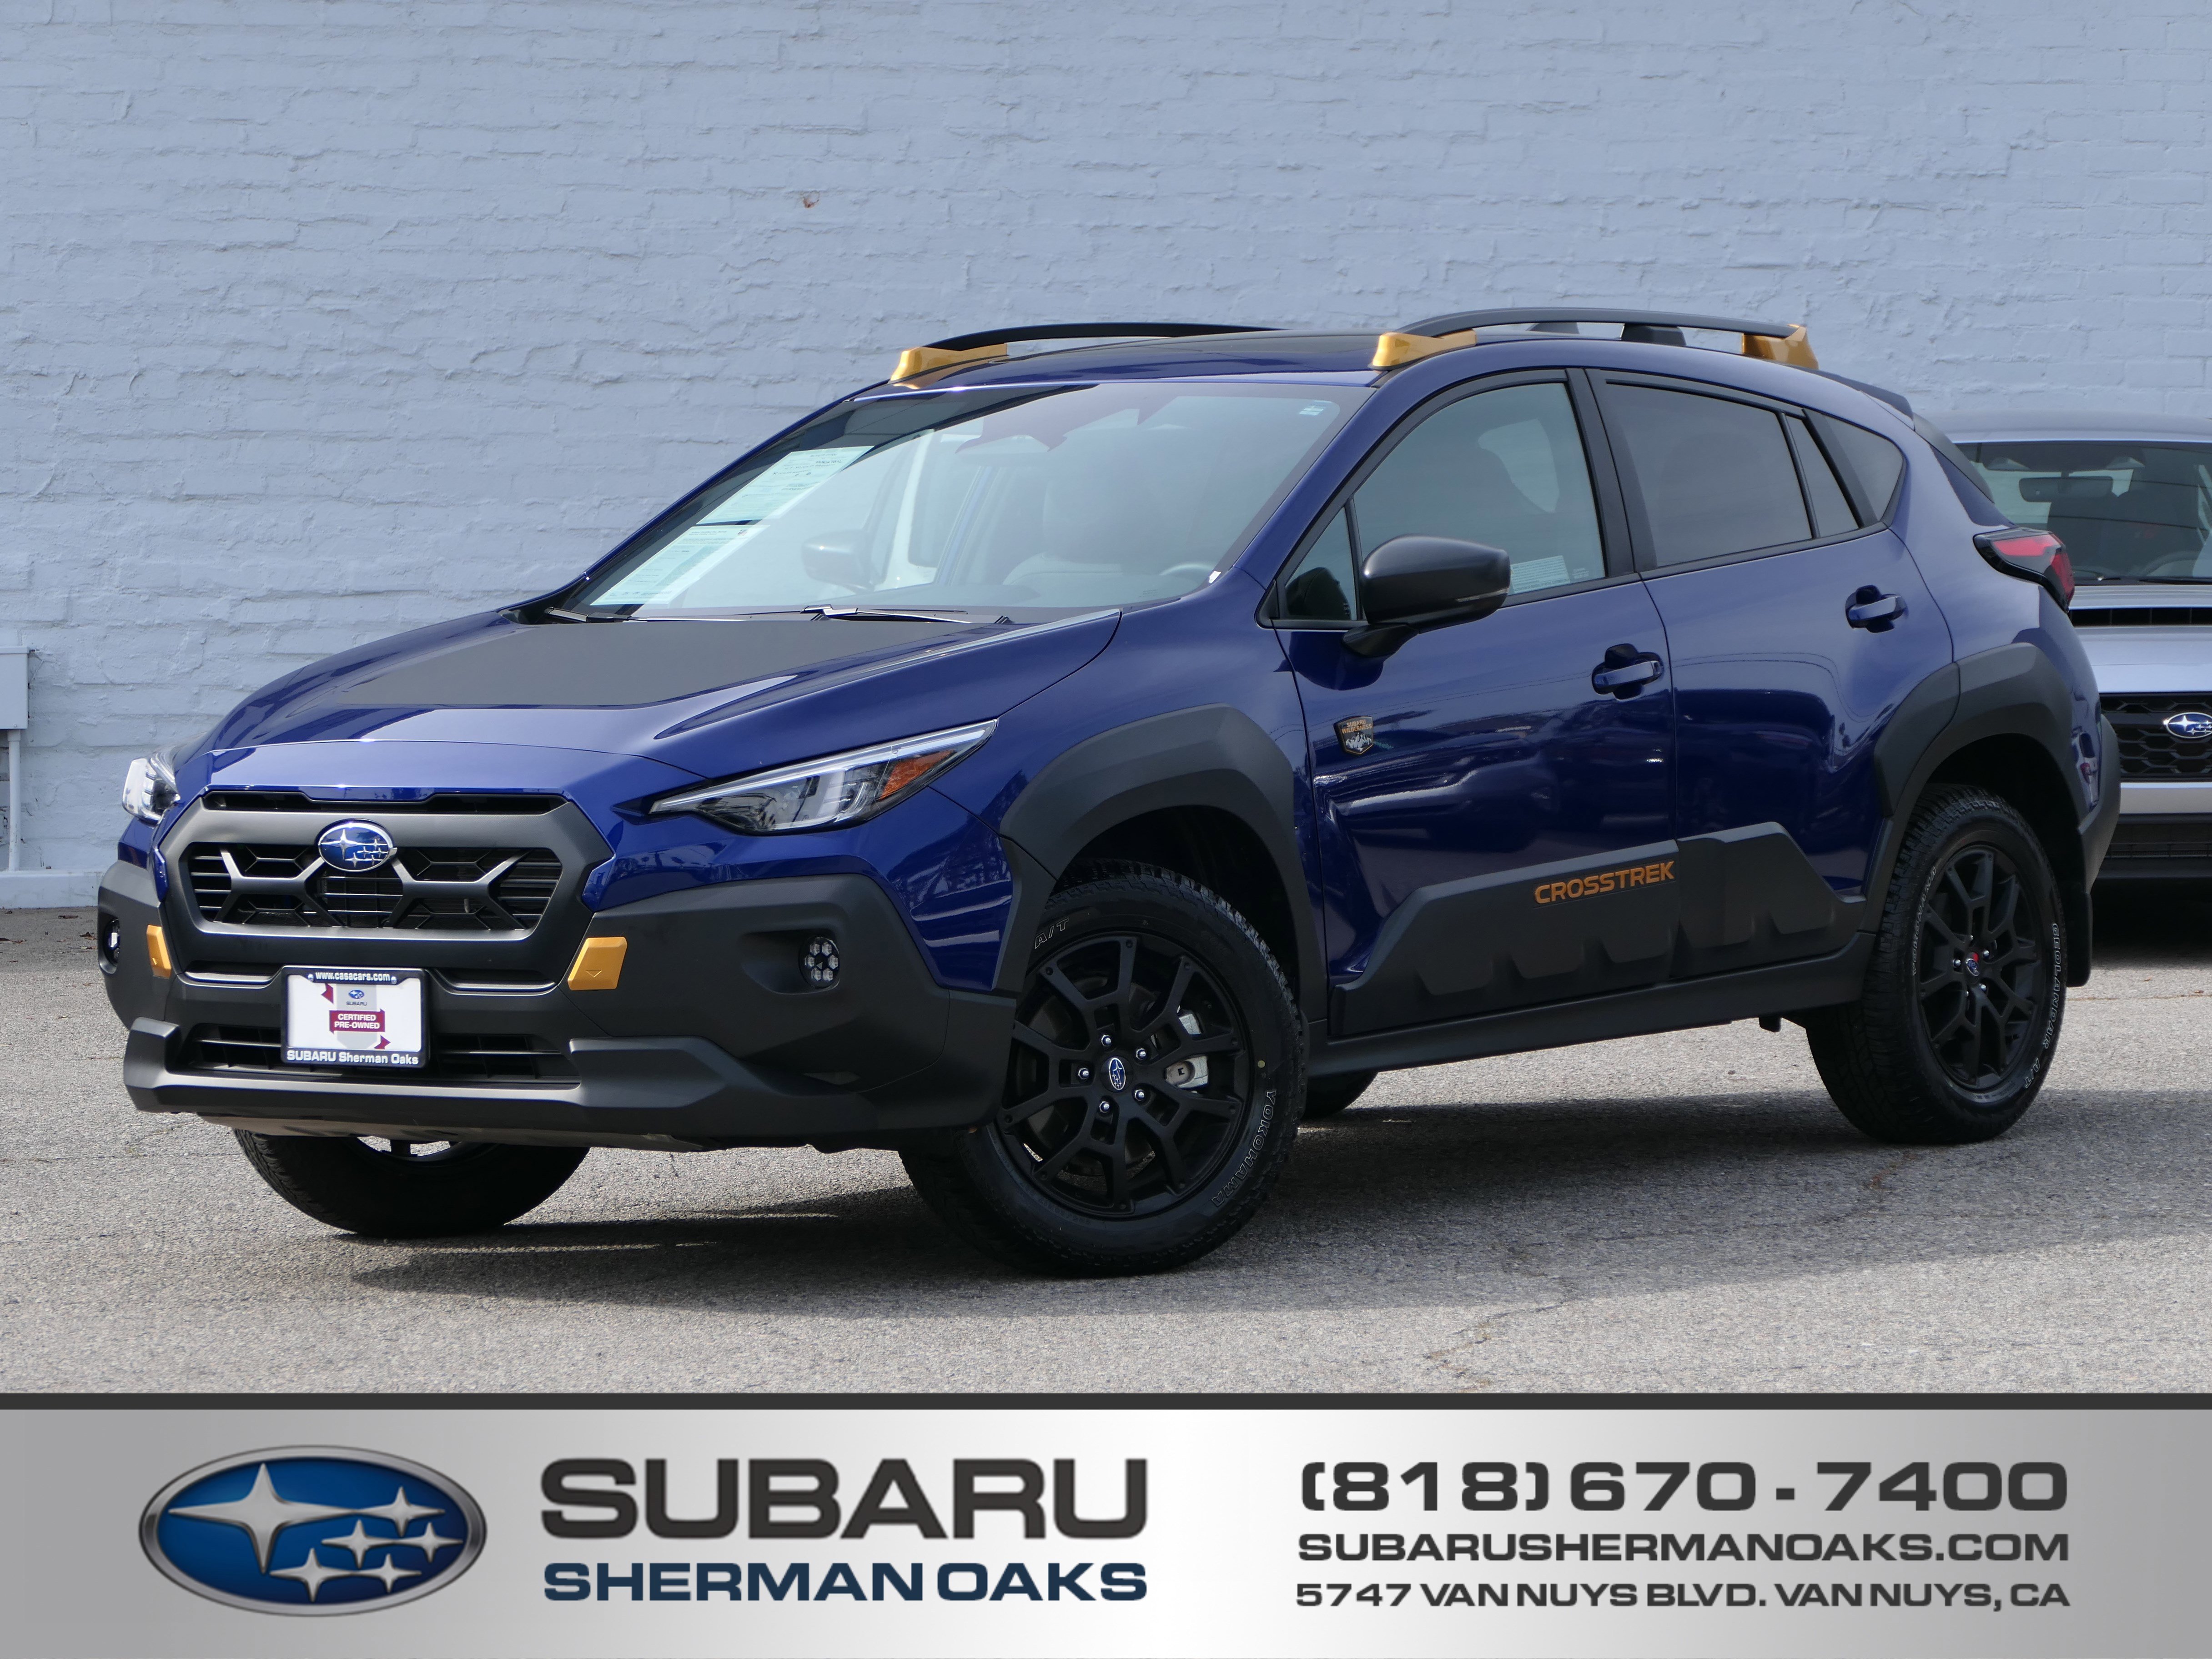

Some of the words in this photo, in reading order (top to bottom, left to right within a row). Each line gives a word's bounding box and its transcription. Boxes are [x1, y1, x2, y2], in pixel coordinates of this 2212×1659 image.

[1342, 724, 1372, 734] WILDERNESS
[1347, 719, 1366, 728] SUBARU
[1534, 861, 1674, 904] CROSSTREK
[1035, 918, 1069, 950] A/T
[315, 972, 391, 981] www.casacars.com
[2042, 923, 2061, 1049] GEOLANDAR
[337, 1013, 377, 1021] CERTIFIED
[287, 1050, 336, 1062] SUBARU
[339, 1052, 388, 1064] Sherman
[391, 1053, 419, 1065] Oaks
[2025, 1057, 2041, 1089] A/T
[1211, 1090, 1277, 1207] YOKOHAMA
